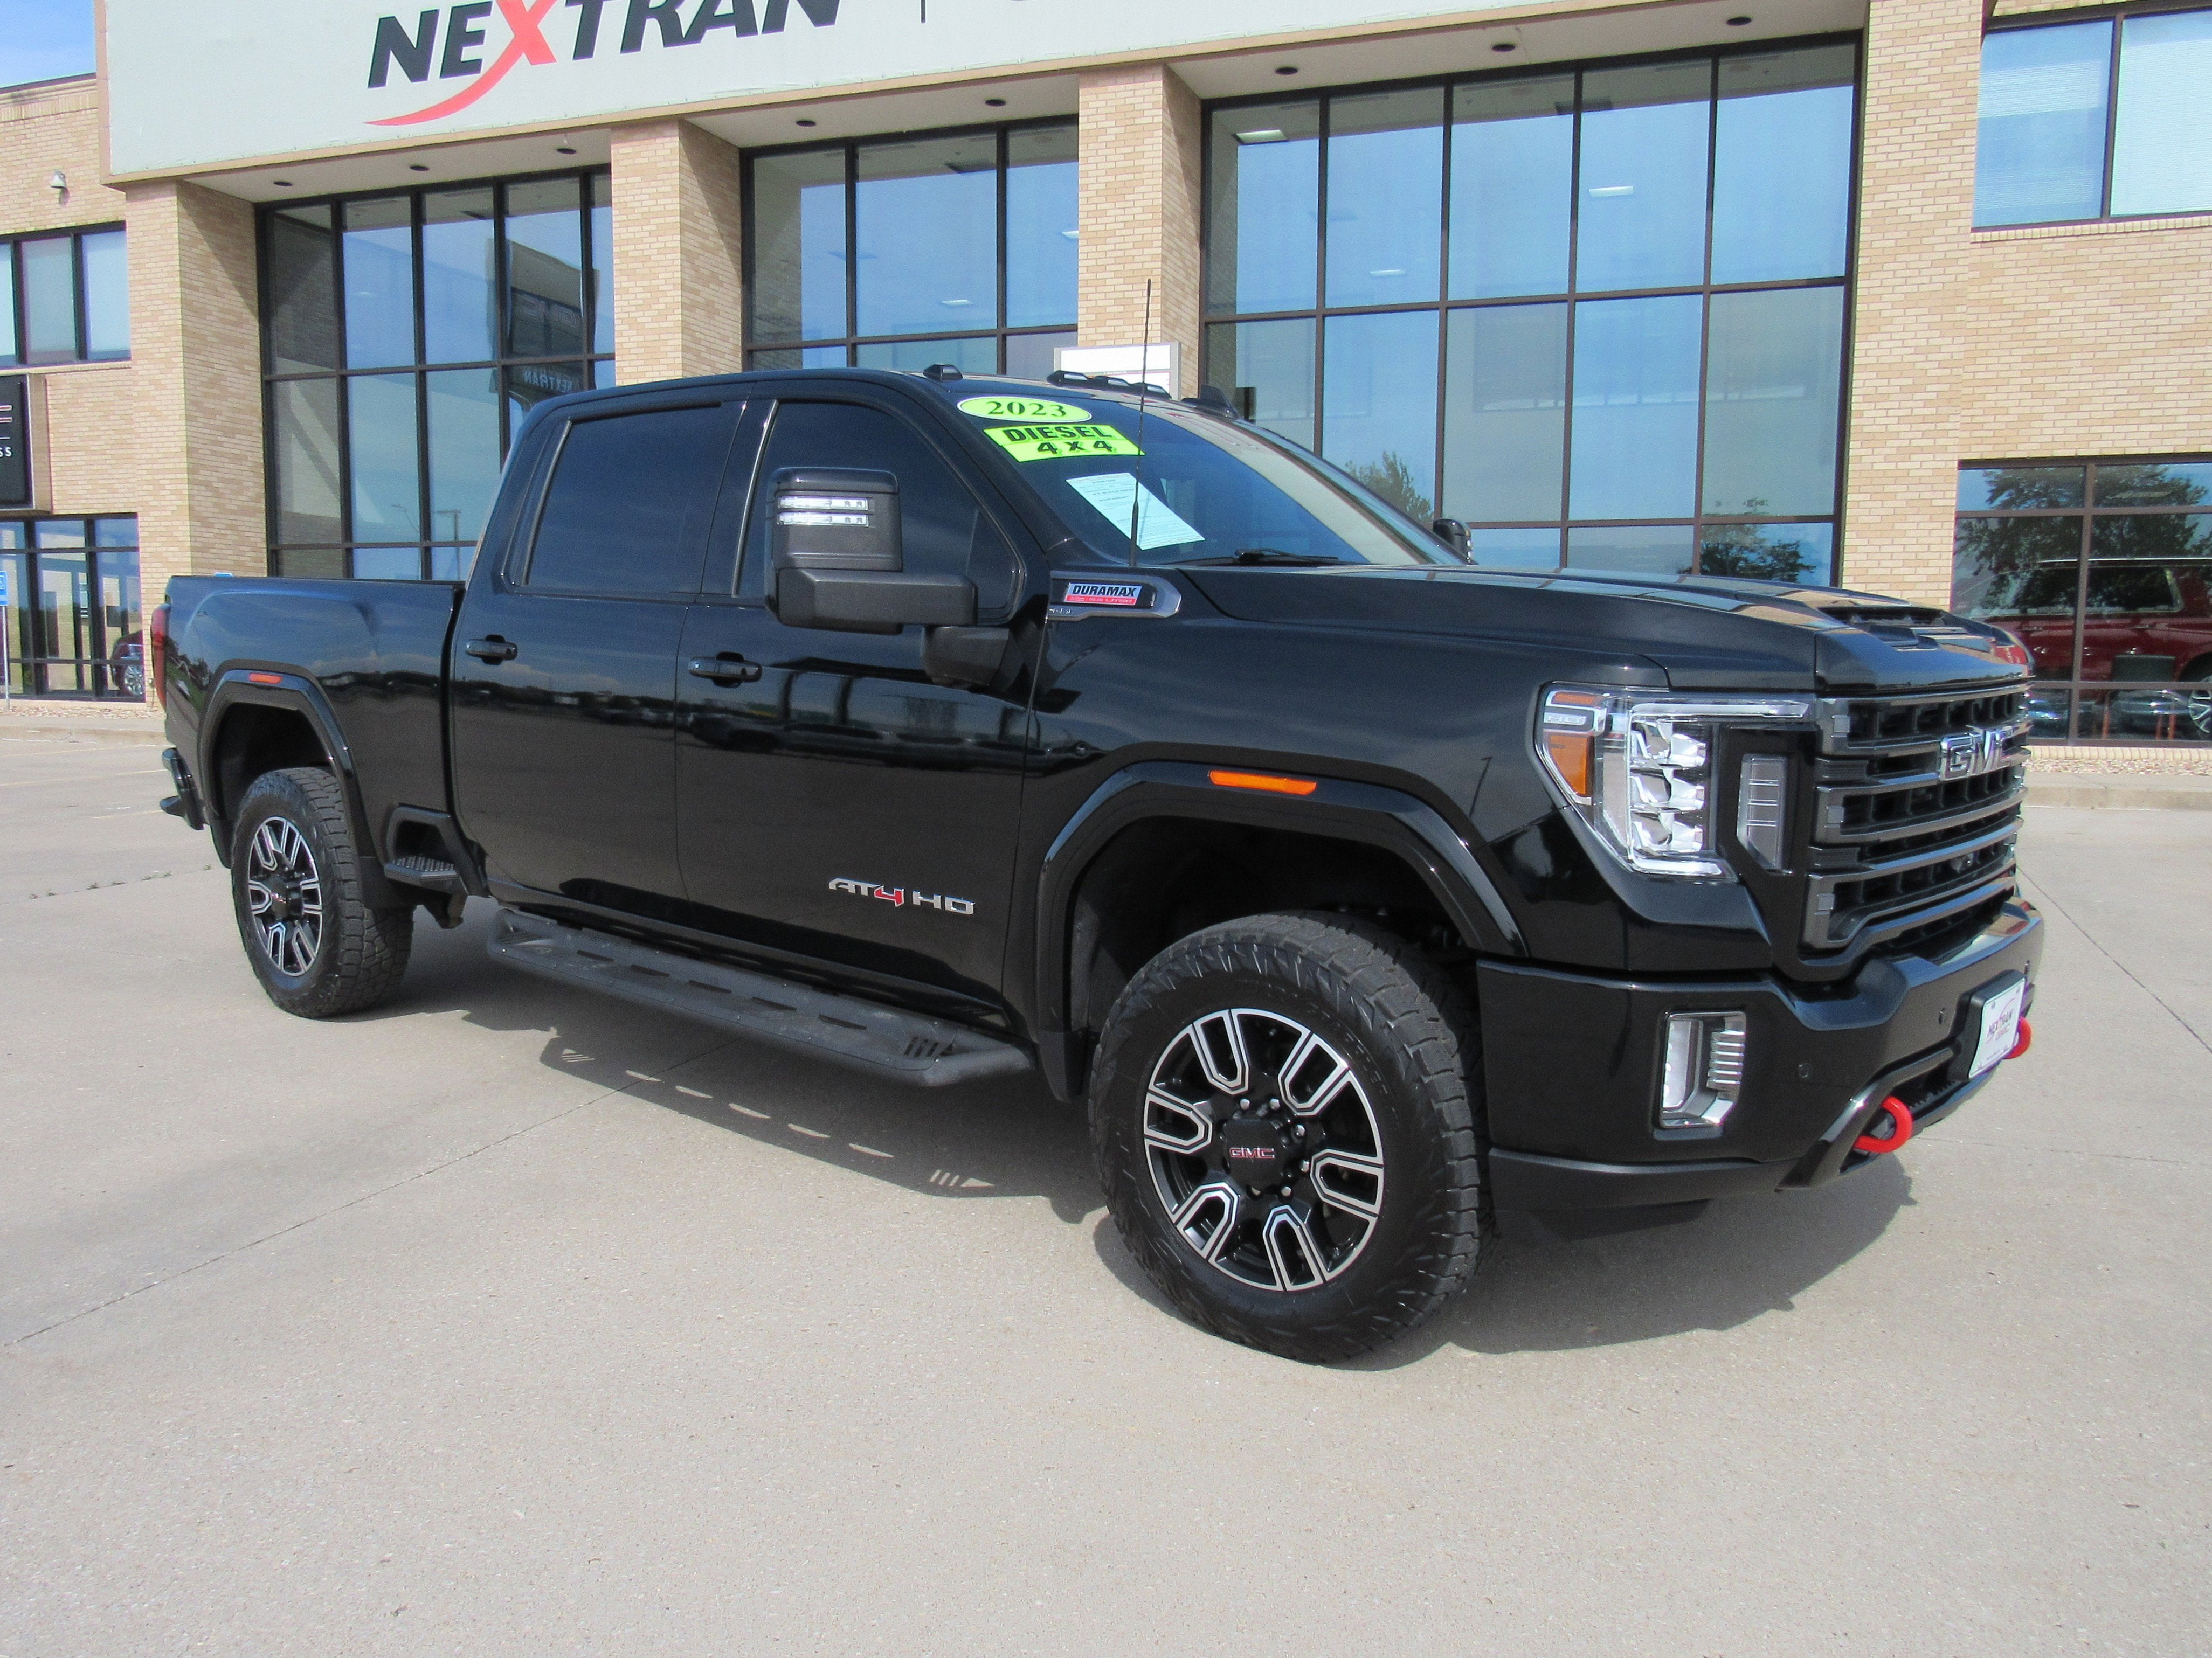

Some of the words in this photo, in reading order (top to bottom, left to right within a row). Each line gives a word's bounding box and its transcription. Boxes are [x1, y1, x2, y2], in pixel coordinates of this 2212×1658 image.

[985, 400, 1067, 418] 2023
[1001, 426, 1113, 442] DIESEL
[1072, 585, 1137, 597] DURAMAX
[828, 877, 905, 907] AT4
[912, 890, 975, 915] HD
[1229, 1147, 1276, 1160] GMC
